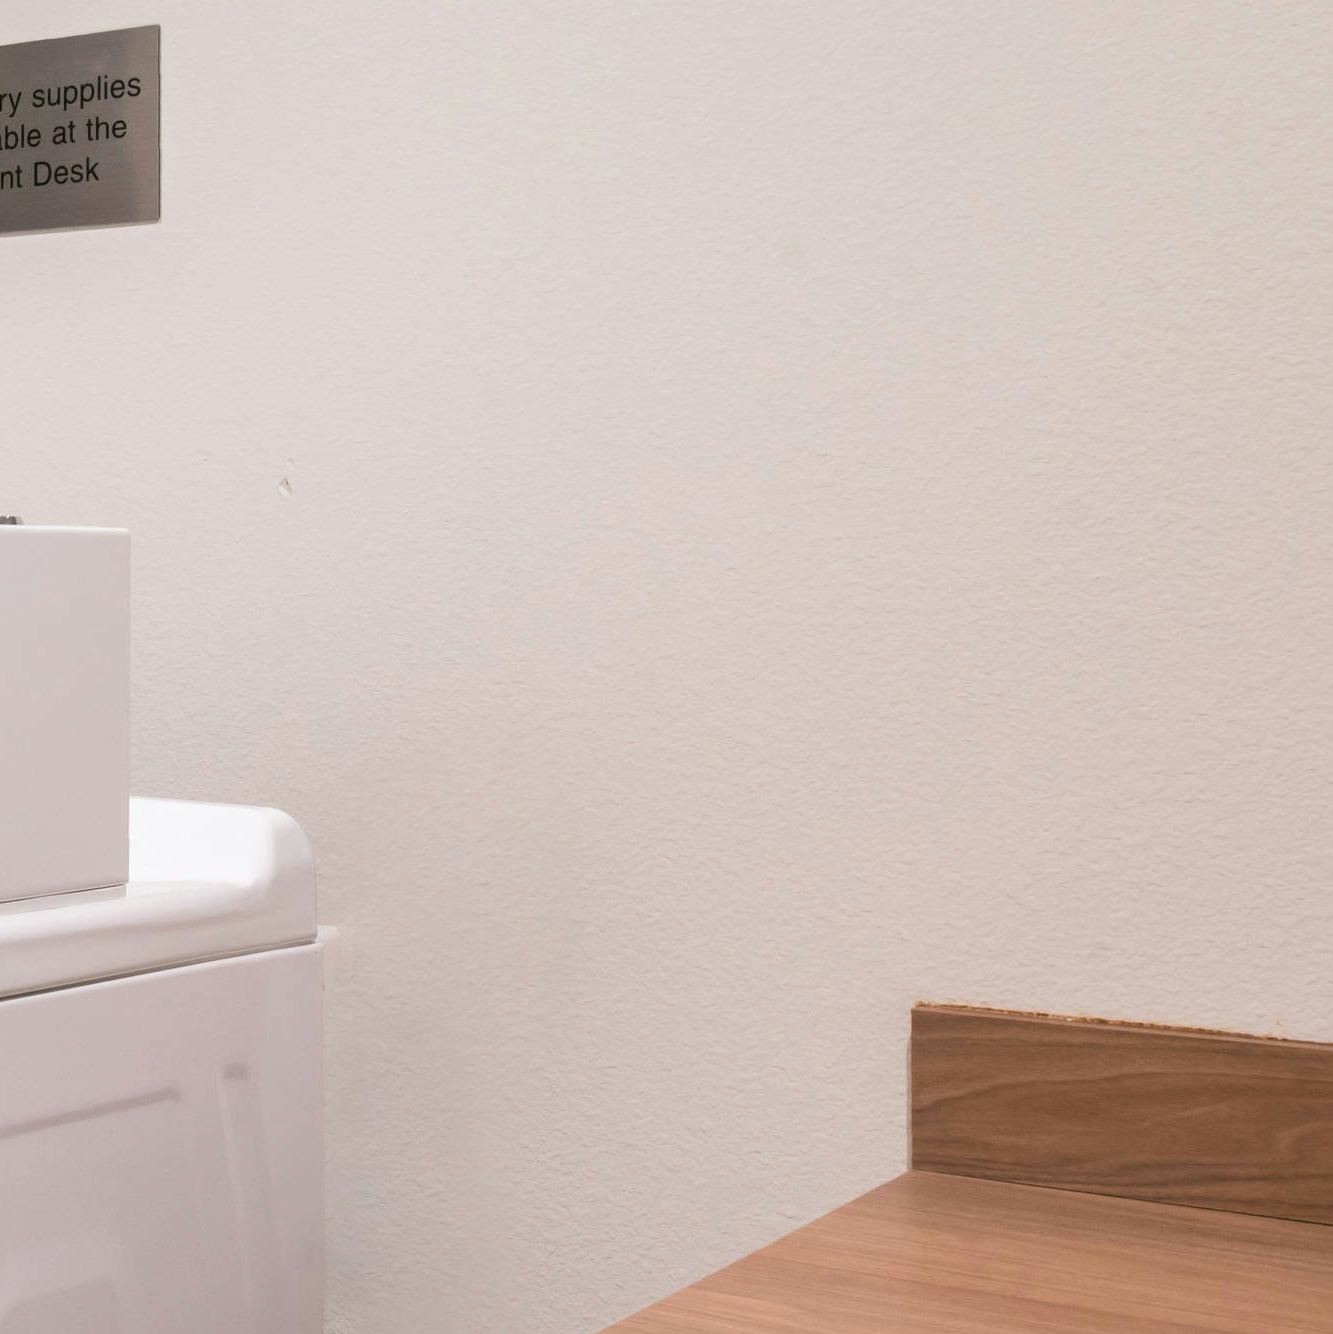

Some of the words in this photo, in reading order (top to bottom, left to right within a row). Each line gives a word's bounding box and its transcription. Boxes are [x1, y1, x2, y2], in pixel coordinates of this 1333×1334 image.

[31, 75, 142, 111] supplies
[52, 121, 76, 145] at
[86, 116, 127, 142] the
[33, 156, 100, 187] Desk
